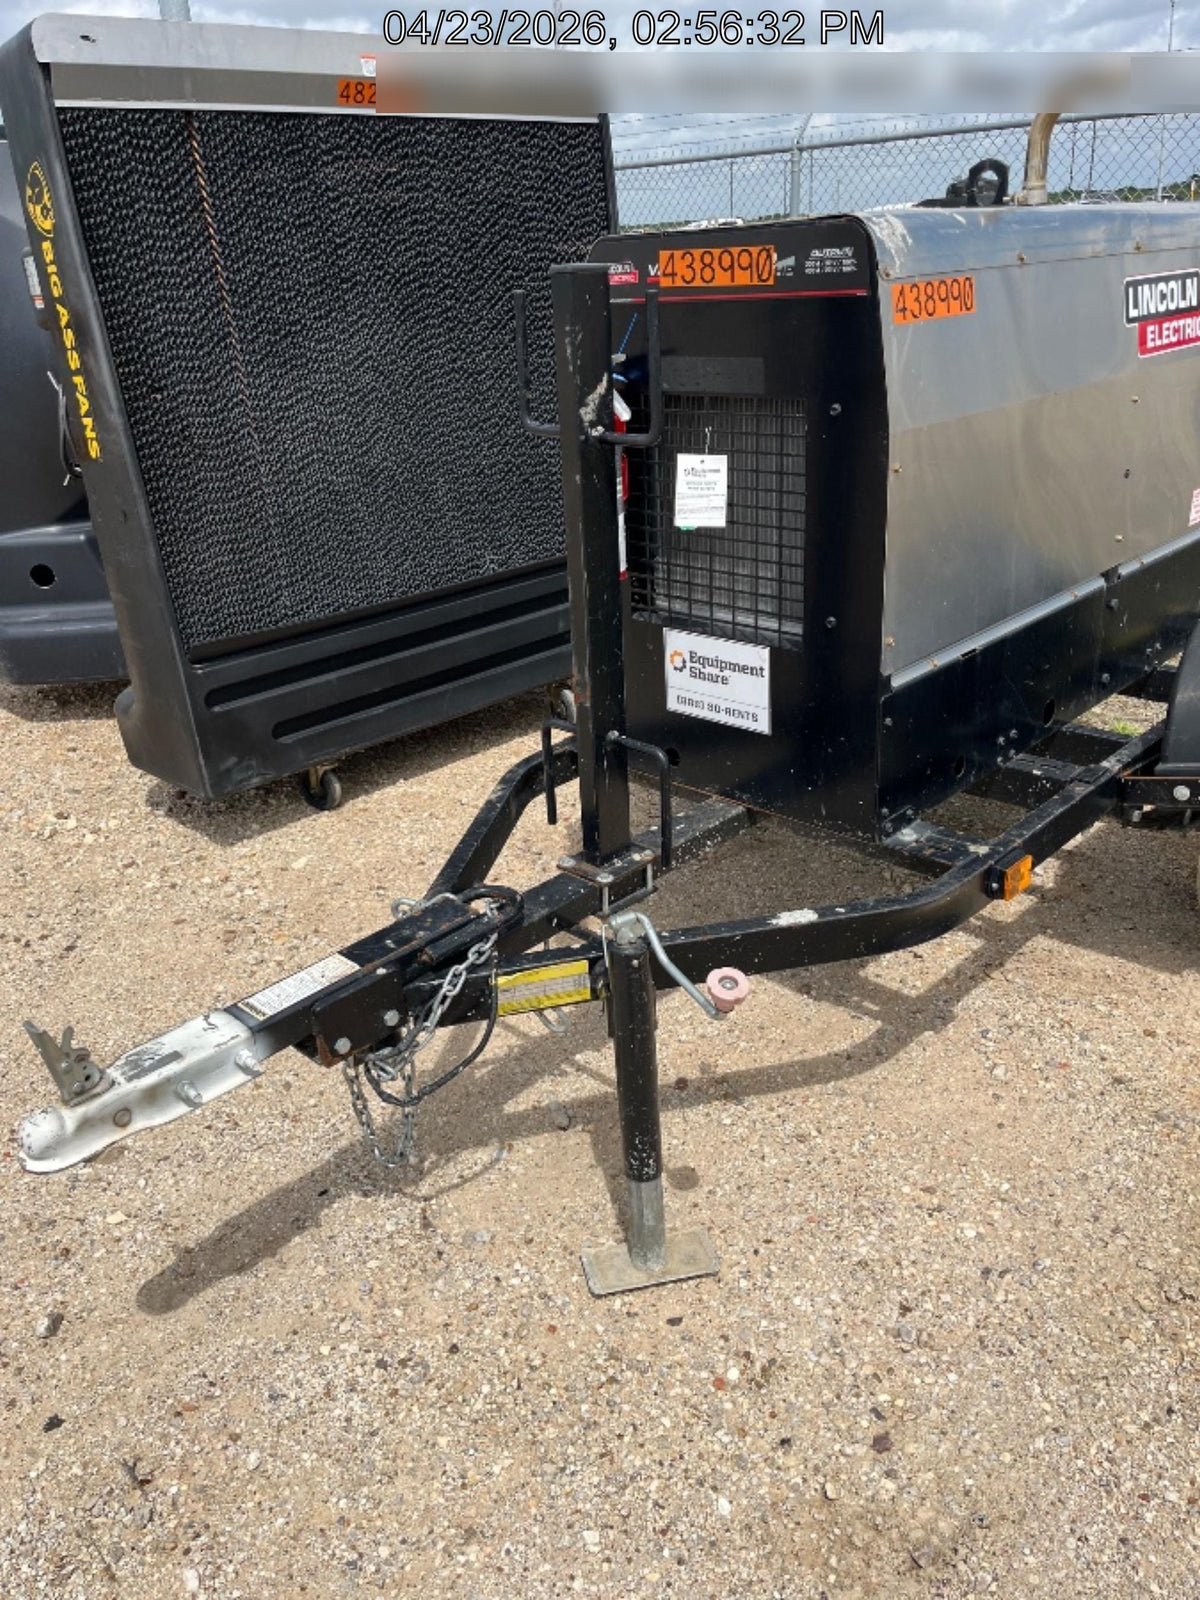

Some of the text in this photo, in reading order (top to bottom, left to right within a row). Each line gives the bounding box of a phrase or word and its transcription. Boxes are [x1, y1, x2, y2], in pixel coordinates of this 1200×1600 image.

[662, 247, 772, 285] 438990
[895, 276, 975, 320] 438990
[1128, 277, 1198, 319] LINCOLN
[42, 239, 101, 459] BIG ASS FANS
[689, 650, 765, 678] Equipment
[689, 666, 729, 685] Share
